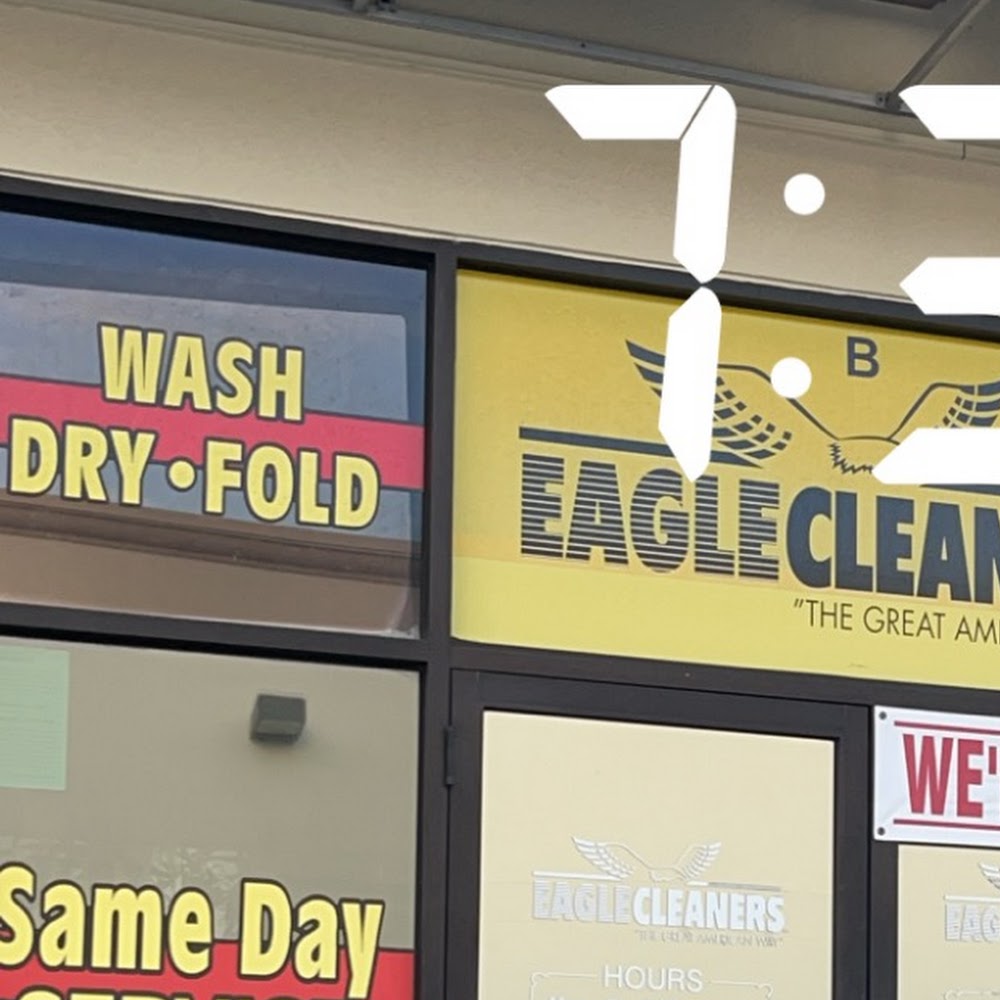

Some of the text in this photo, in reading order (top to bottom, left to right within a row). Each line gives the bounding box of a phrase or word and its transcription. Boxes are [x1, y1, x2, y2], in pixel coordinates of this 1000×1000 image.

[99, 322, 304, 422] WASH
[846, 336, 880, 378] B
[520, 453, 780, 581] EAGLE
[863, 604, 945, 640] GREAT
[0, 861, 214, 979] Same
[632, 887, 786, 934] CLEANERS
[603, 964, 704, 994] HOURS
